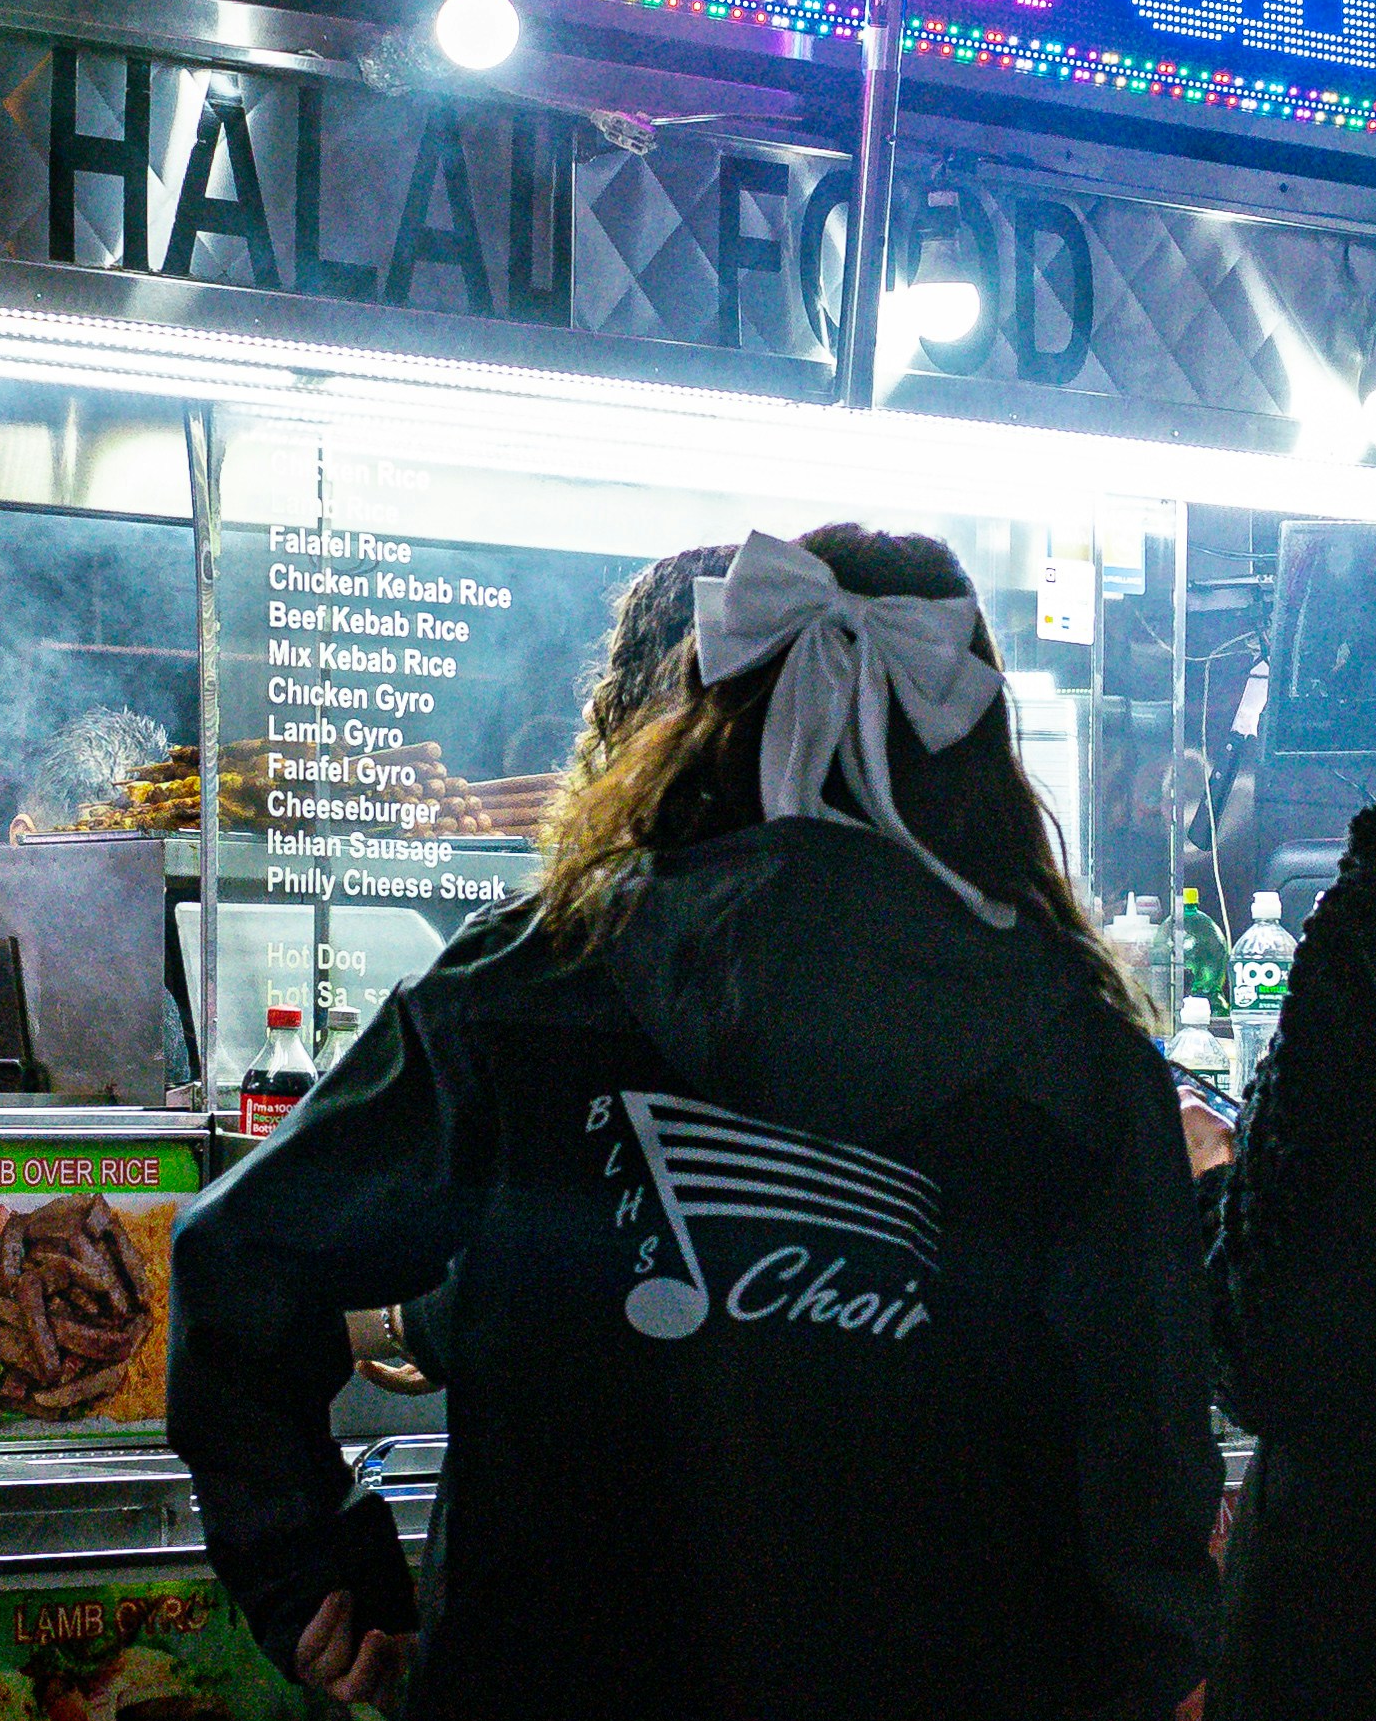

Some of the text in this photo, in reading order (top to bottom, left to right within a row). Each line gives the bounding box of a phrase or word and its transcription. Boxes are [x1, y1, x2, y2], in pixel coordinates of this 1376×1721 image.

[269, 525, 412, 563] Falafel Rice
[270, 564, 512, 609] Chicken Kebab Rice
[269, 601, 470, 642] Beef Kebab Rice
[269, 640, 457, 678] Mix Kebab Rice
[268, 678, 434, 718] Chicken Gyro
[268, 715, 404, 753] Lamb Gyro
[268, 753, 416, 791] Falafel Gyro
[268, 791, 440, 829] Cheeseburger
[267, 829, 453, 869] Italian Sausage
[267, 867, 505, 902] Philly Cheese Steak
[267, 942, 310, 969] Hot
[23, 1159, 96, 1186] OVER
[101, 1159, 159, 1186] RICE
[727, 1245, 931, 1340] Choir
[14, 1605, 104, 1646] LAMB
